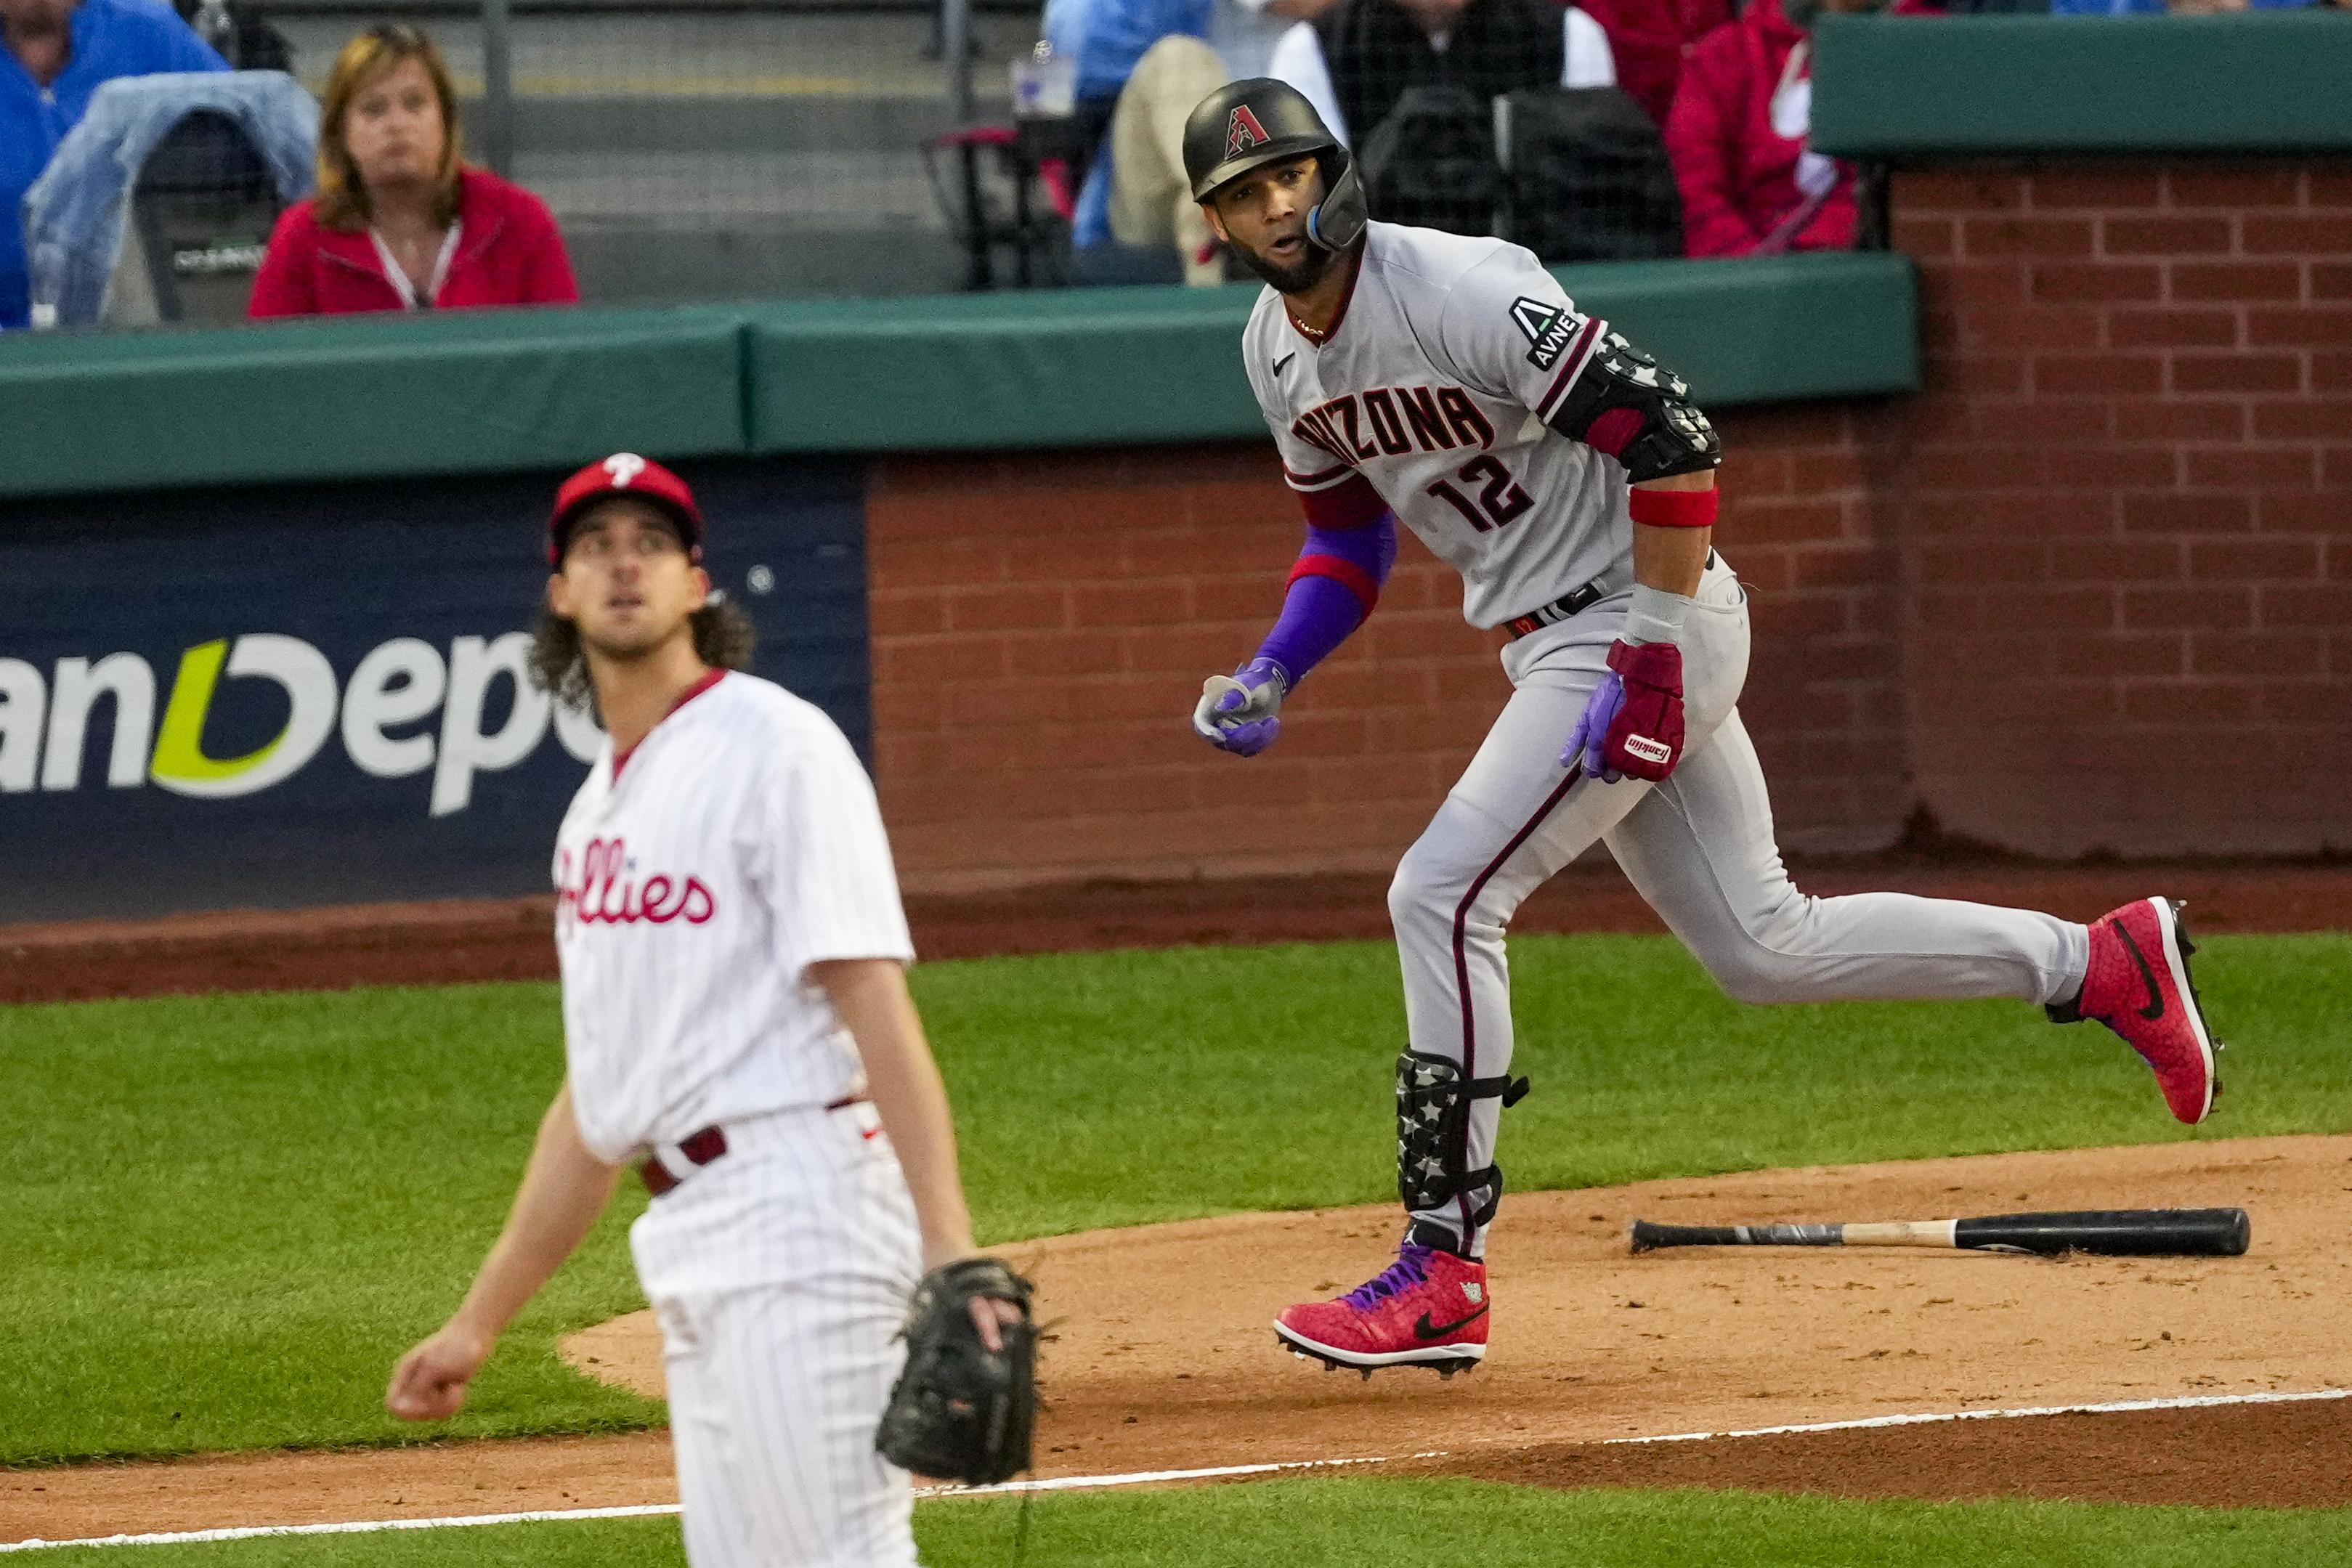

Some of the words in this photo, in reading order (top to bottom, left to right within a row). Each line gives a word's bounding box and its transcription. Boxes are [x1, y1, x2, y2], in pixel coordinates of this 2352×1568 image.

[1534, 310, 1576, 366] AVNE
[1291, 386, 1496, 468] ARIZONA
[1426, 454, 1536, 533] 12
[558, 837, 716, 924] llies
